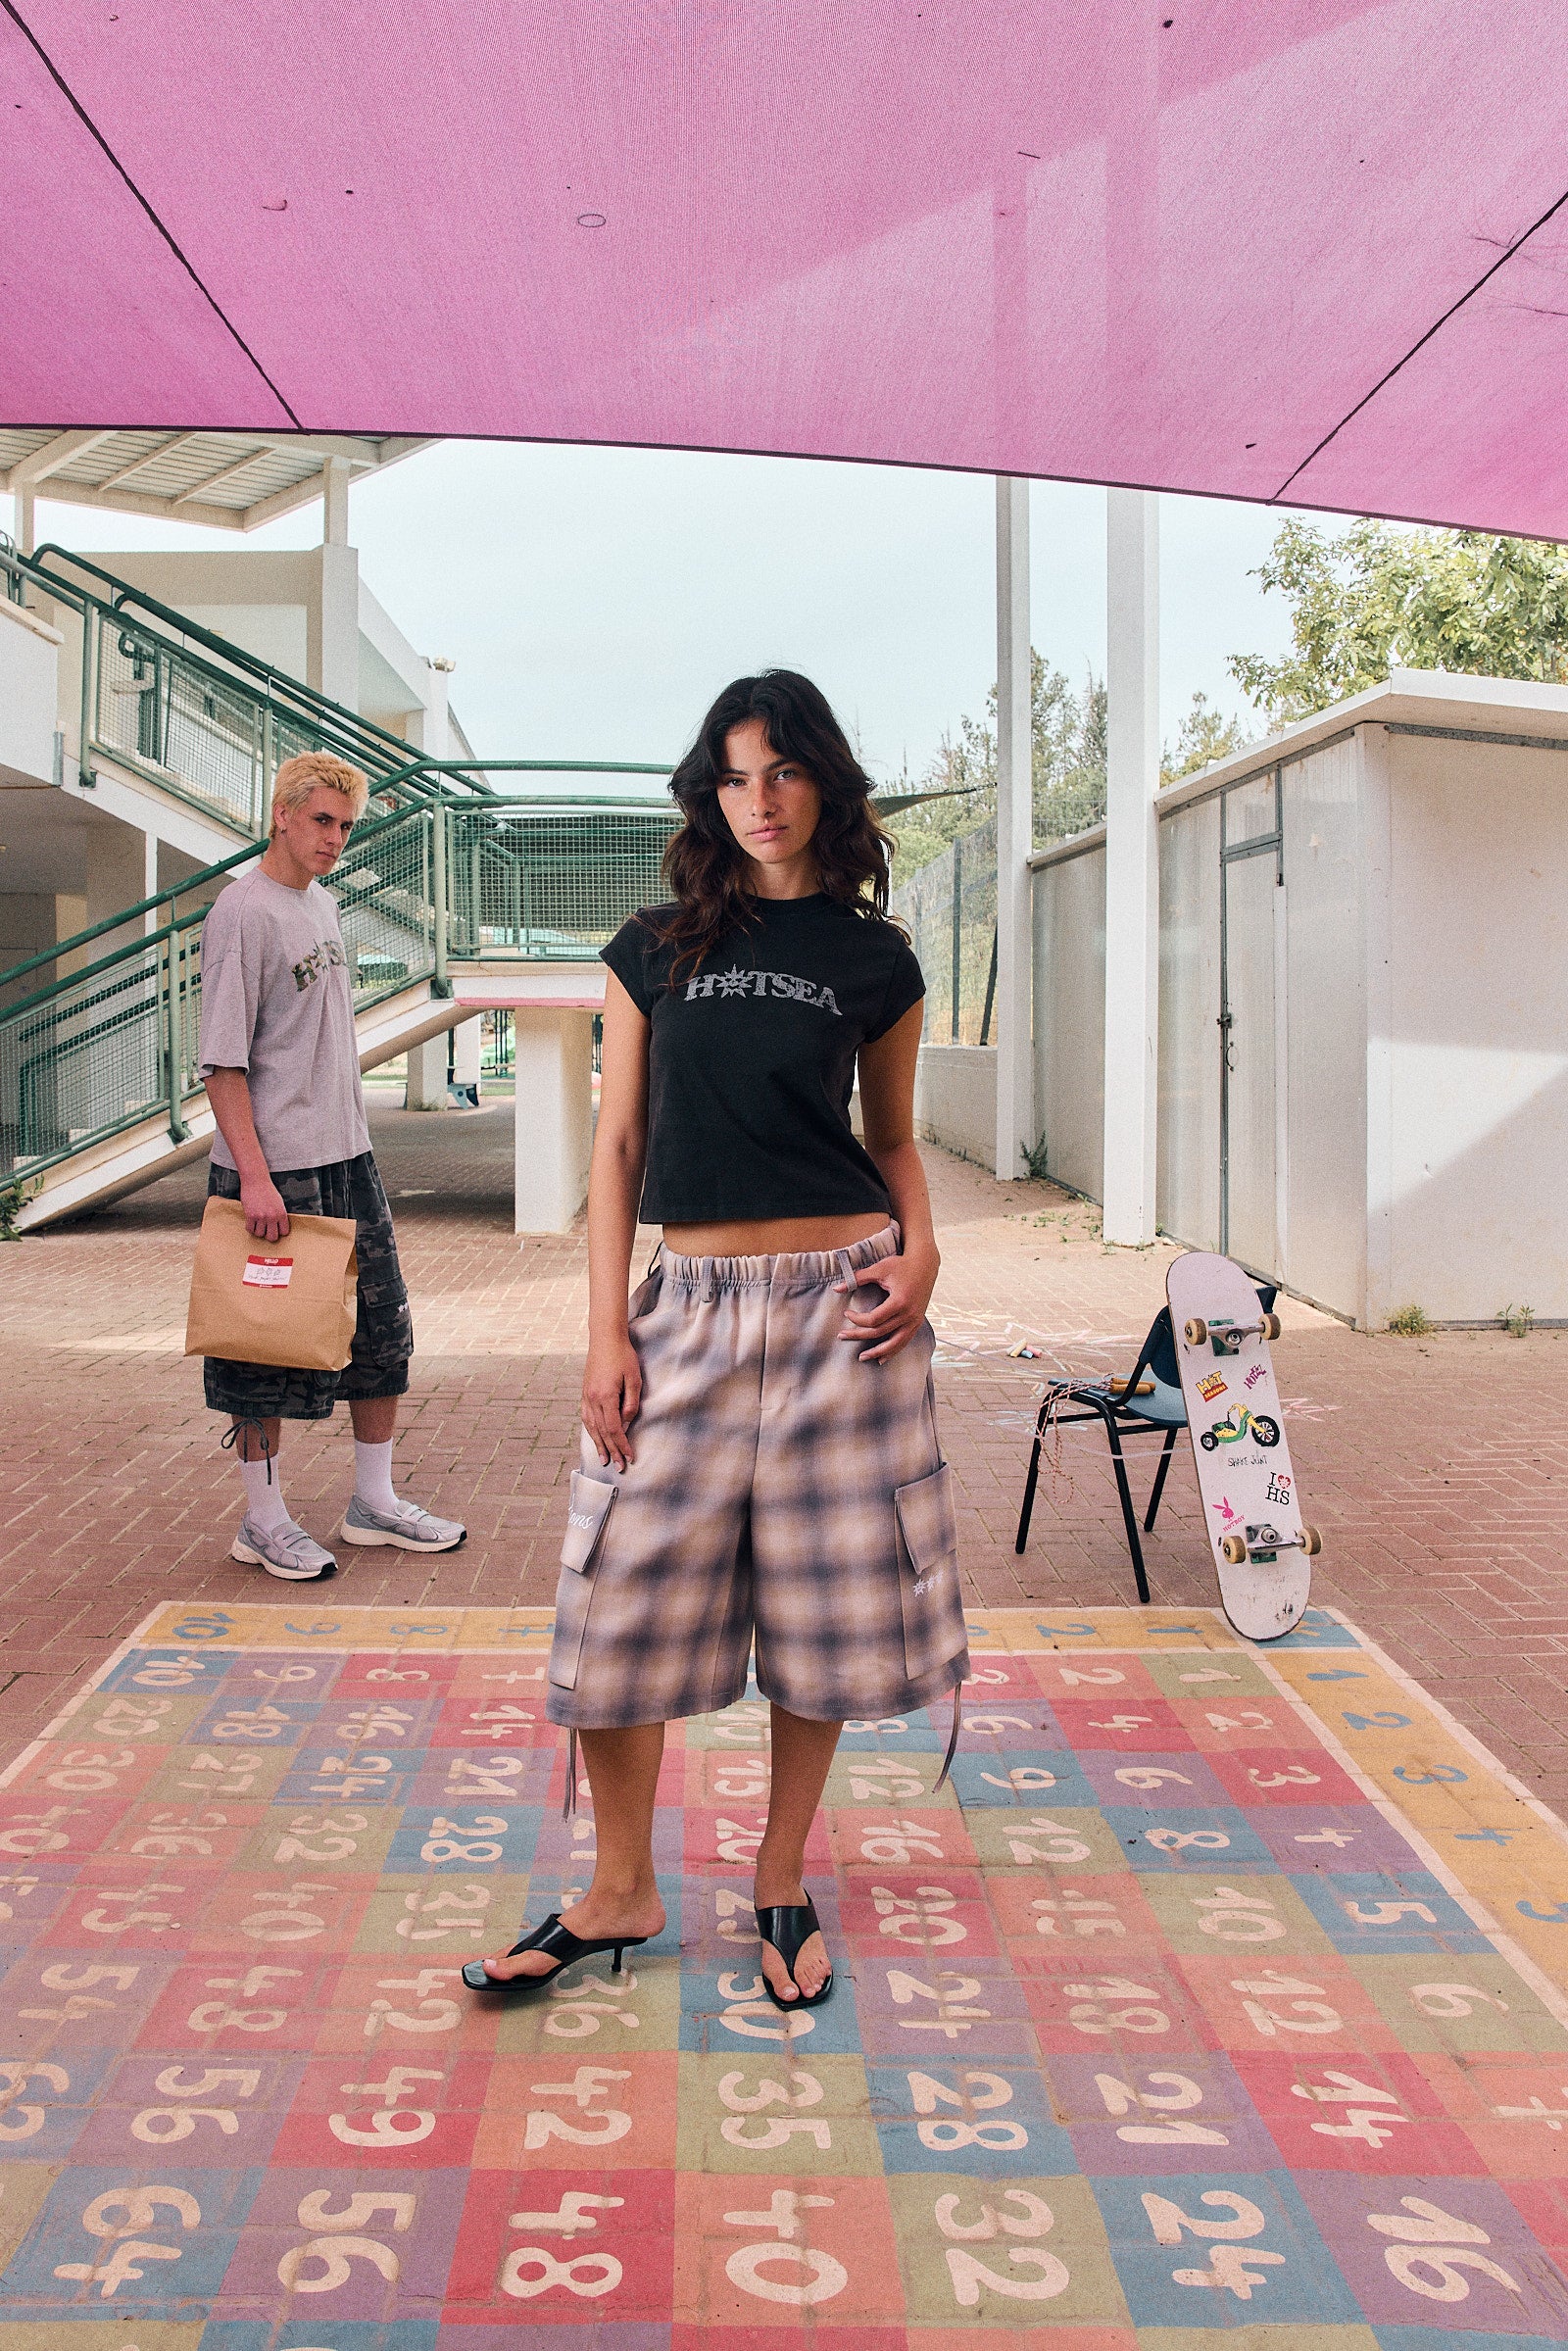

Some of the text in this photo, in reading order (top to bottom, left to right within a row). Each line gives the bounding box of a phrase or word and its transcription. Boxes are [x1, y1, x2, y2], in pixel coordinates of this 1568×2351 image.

[1203, 1385, 1227, 1398] SEASONS
[1265, 1485, 1290, 1505] HS
[1269, 1471, 1276, 1487] I
[1223, 1514, 1246, 1532] HOTBOY
[173, 1613, 237, 1640] 10
[284, 1622, 341, 1637] 9
[391, 1623, 448, 1636] 8
[1036, 1623, 1096, 1640] 2
[1147, 1625, 1204, 1636] 1
[133, 1655, 206, 1687] 10
[253, 1665, 318, 1684] 9
[366, 1667, 431, 1682] 8
[481, 1666, 545, 1685] 7
[1058, 1667, 1126, 1686] 2
[1179, 1667, 1242, 1684] 1
[1305, 1668, 1370, 1682] 1
[93, 1697, 173, 1737] 20
[212, 1705, 291, 1739] 18
[334, 1705, 415, 1741] 16
[461, 1704, 536, 1739] 14
[962, 1715, 1033, 1735] 6
[1088, 1715, 1152, 1734] 4
[1203, 1711, 1273, 1733] 2
[1342, 1711, 1411, 1732] 2
[47, 1749, 135, 1791] 30
[178, 1753, 264, 1793] 27
[310, 1755, 394, 1798] 24
[444, 1755, 523, 1797] 21
[848, 1758, 925, 1800] 12
[980, 1767, 1056, 1789] 9
[1114, 1767, 1194, 1789] 6
[1247, 1765, 1321, 1788] 3
[1393, 1764, 1468, 1786] 3
[130, 1812, 228, 1860] 36
[273, 1813, 369, 1863] 32
[420, 1815, 509, 1864] 28
[860, 1820, 945, 1864] 16
[1003, 1817, 1091, 1864] 12
[1144, 1828, 1231, 1850] 8
[1295, 1828, 1362, 1848] 4
[1454, 1828, 1521, 1846] 4
[81, 1883, 185, 1934] 45
[240, 1883, 340, 1941] 40
[396, 1884, 491, 1940] 35
[871, 1886, 968, 1945] 20
[1191, 1886, 1287, 1941] 10
[1344, 1900, 1438, 1925] 5
[18, 1964, 139, 2021] 54
[187, 1965, 304, 2033] 48
[364, 1968, 464, 2035] 42
[544, 1969, 640, 2037] 36
[886, 1970, 992, 2038] 24
[1062, 1976, 1171, 2034] 18
[1231, 1970, 1344, 2035] 12
[1410, 1983, 1508, 2017] 6
[130, 2065, 262, 2143] 56
[328, 2066, 446, 2147] 49
[523, 2066, 632, 2149] 42
[717, 2071, 832, 2150] 35
[907, 2071, 1028, 2151] 28
[1094, 2072, 1230, 2145] 21
[1291, 2071, 1411, 2148] 14
[53, 2185, 202, 2298] 64
[277, 2188, 418, 2294] 56
[502, 2191, 625, 2298] 48
[723, 2188, 849, 2305] 40
[935, 2189, 1070, 2306] 32
[1142, 2190, 1286, 2299] 24
[1367, 2196, 1522, 2302] 16
